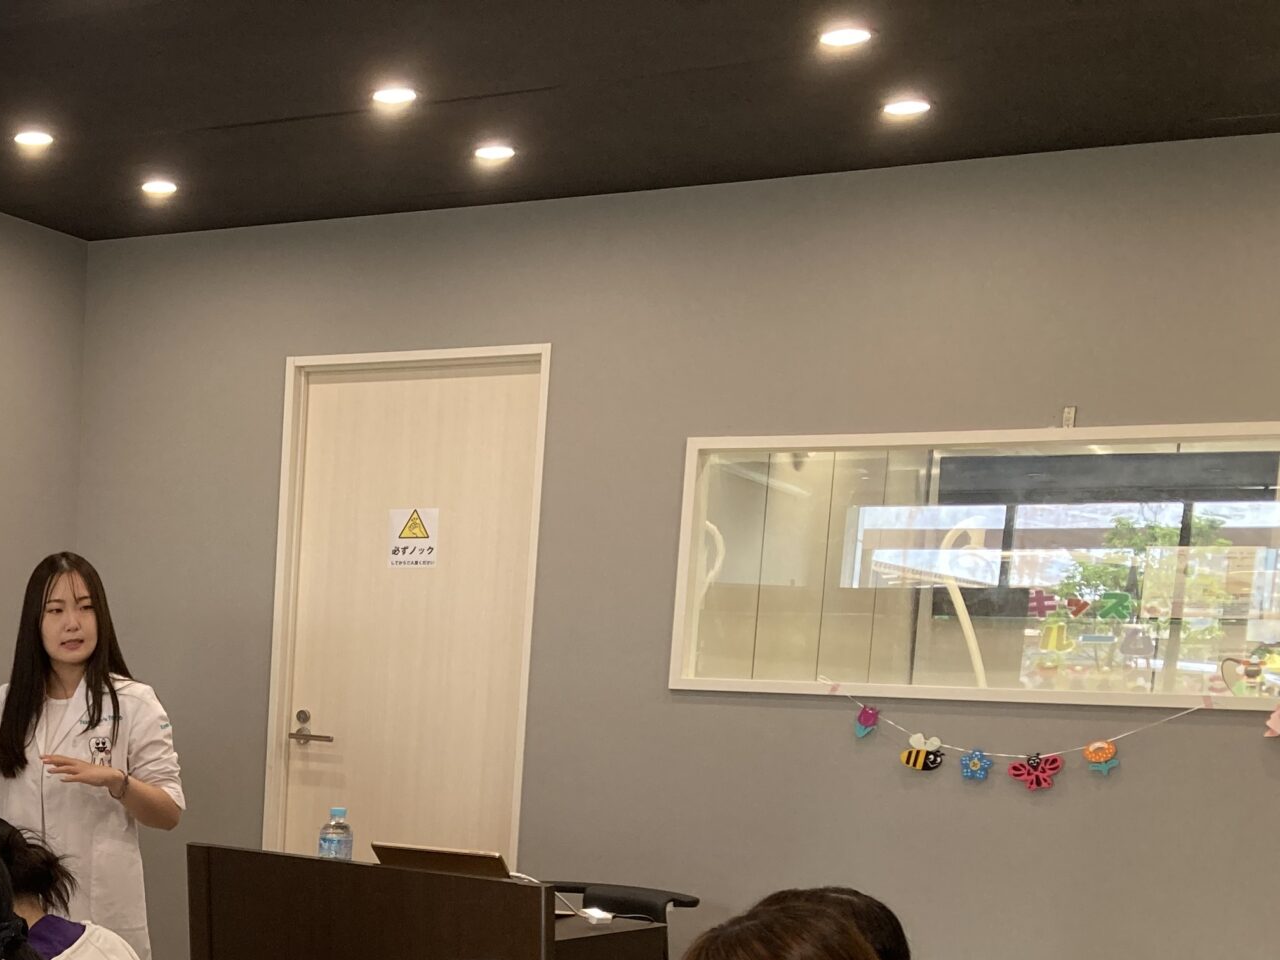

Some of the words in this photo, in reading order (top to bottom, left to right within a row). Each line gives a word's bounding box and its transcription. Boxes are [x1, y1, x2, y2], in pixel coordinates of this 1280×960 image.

[391, 546, 434, 555] 必ずノック
